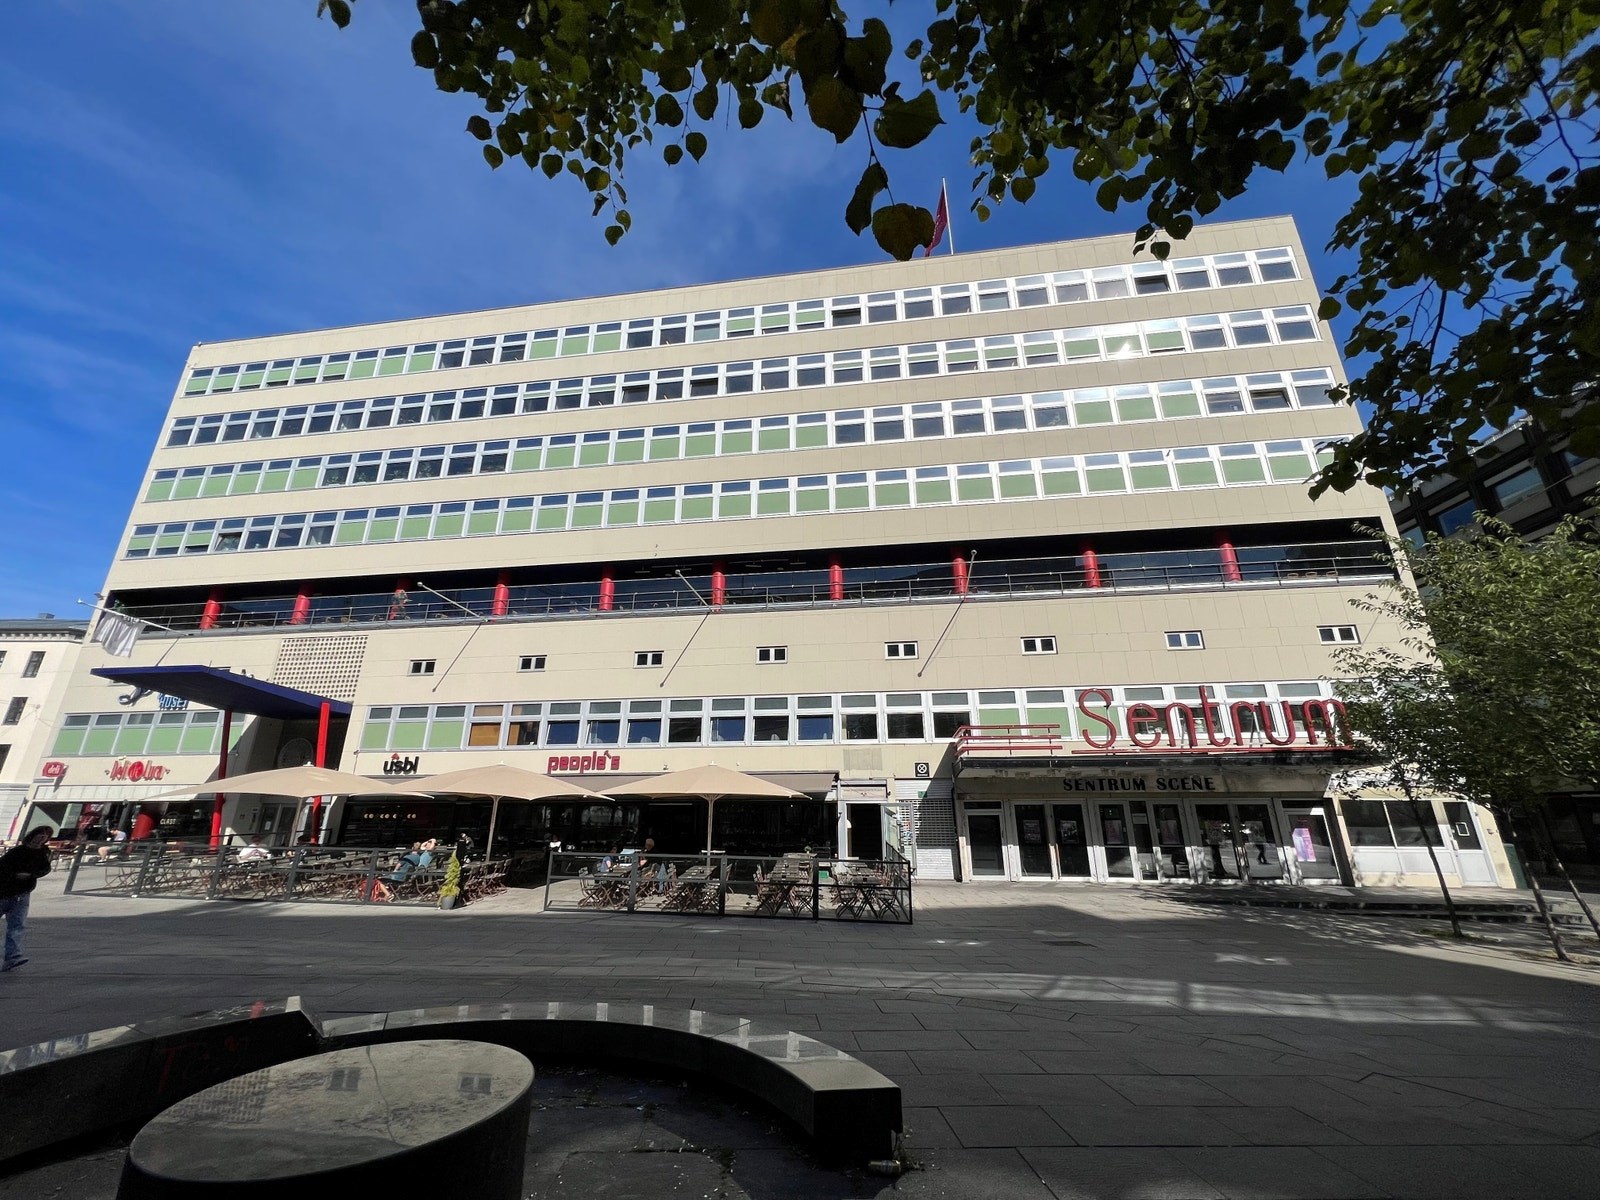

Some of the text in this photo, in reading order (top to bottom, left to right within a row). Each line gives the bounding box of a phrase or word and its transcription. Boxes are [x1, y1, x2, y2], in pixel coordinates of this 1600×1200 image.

[1078, 685, 1353, 748] Sentrum
[383, 755, 419, 774] usbl
[547, 750, 620, 774] people's
[1063, 776, 1215, 791] SENTRUM SCENE
